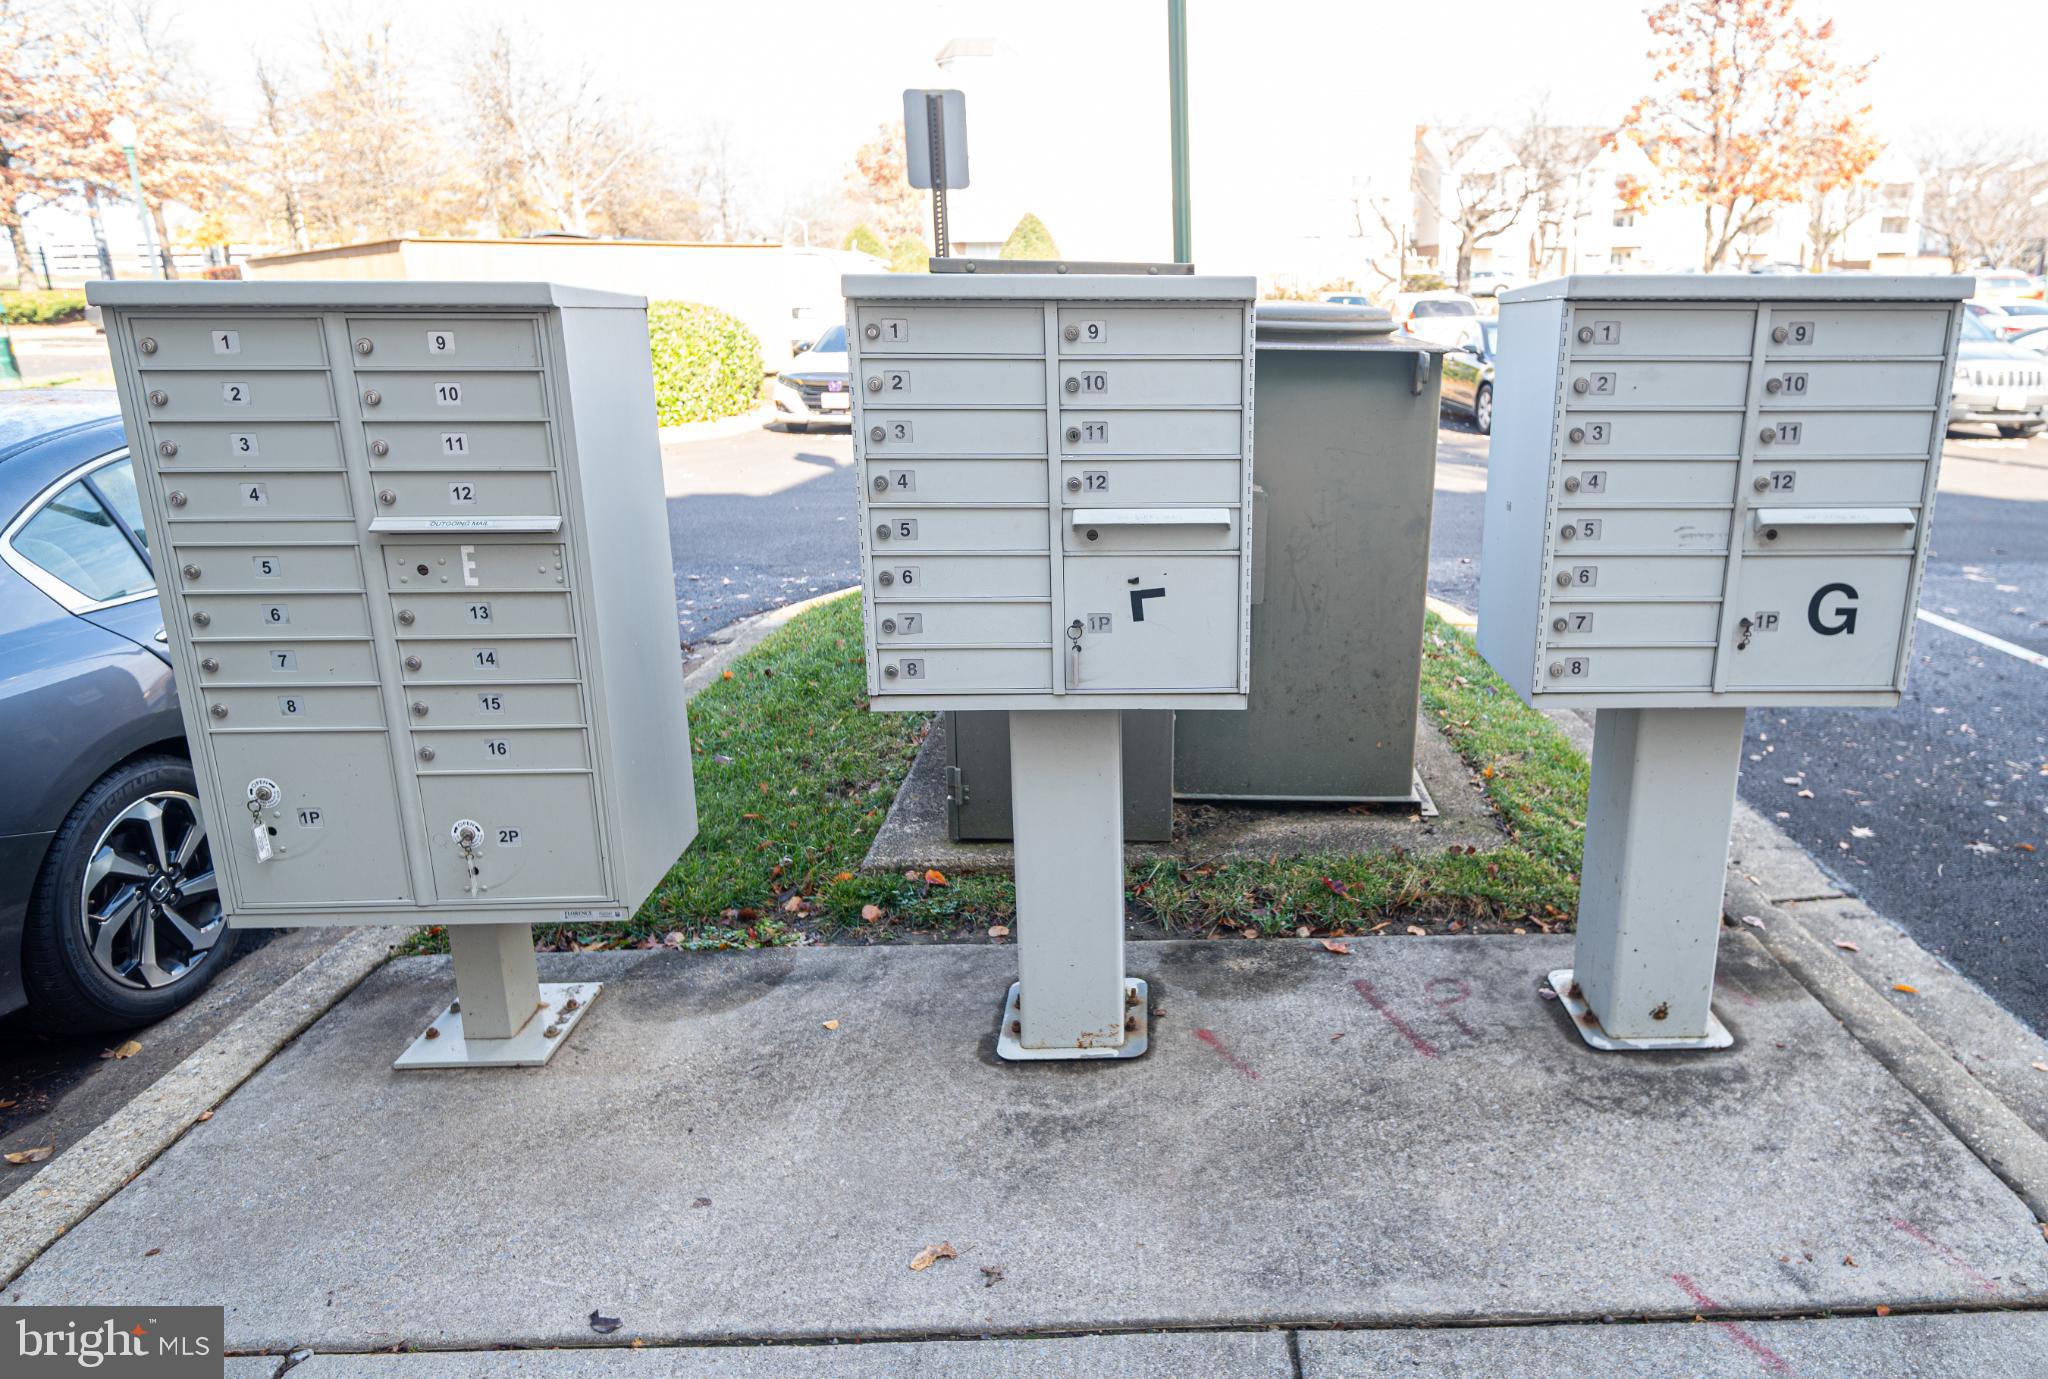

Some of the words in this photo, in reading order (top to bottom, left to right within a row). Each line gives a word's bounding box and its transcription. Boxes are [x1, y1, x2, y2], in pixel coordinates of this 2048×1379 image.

[889, 322, 898, 339] 1
[1087, 323, 1099, 340] 9
[1602, 325, 1611, 341] 1
[1795, 325, 1807, 342] 9
[221, 334, 230, 350] 1
[435, 335, 446, 351] 9
[891, 374, 903, 391] 2
[1083, 375, 1105, 391] 10
[1596, 376, 1608, 392] 2
[1784, 376, 1806, 392] 10
[230, 386, 242, 402] 2
[439, 386, 459, 401] 10
[894, 424, 906, 440] 3
[1085, 425, 1104, 440] 11
[1592, 425, 1603, 441] 3
[1779, 425, 1798, 441] 11
[239, 437, 250, 452] 3
[445, 436, 464, 451] 11
[897, 473, 909, 489] 4
[1085, 474, 1107, 490] 12
[1588, 474, 1599, 489] 4
[1772, 474, 1793, 489] 12
[249, 487, 260, 502] 4
[452, 486, 473, 501] 12
[900, 522, 911, 537] 5
[1583, 522, 1595, 538] 5
[262, 560, 272, 575] 5
[460, 544, 479, 586] E
[902, 569, 913, 585] 6
[1579, 569, 1590, 584] 6
[270, 607, 281, 622] 6
[469, 605, 489, 620] 13
[1807, 582, 1859, 636] G
[904, 616, 915, 630] 7
[1089, 616, 1111, 631] 1P
[1575, 615, 1587, 630] 7
[1756, 614, 1778, 629] 1P
[277, 654, 287, 668] 7
[476, 651, 496, 665] 14
[907, 662, 918, 677] 8
[1571, 660, 1582, 675] 8
[286, 699, 297, 713] 8
[481, 697, 501, 711] 15
[488, 742, 507, 756] 16
[300, 811, 320, 824] 1P
[498, 830, 519, 843] 2P
